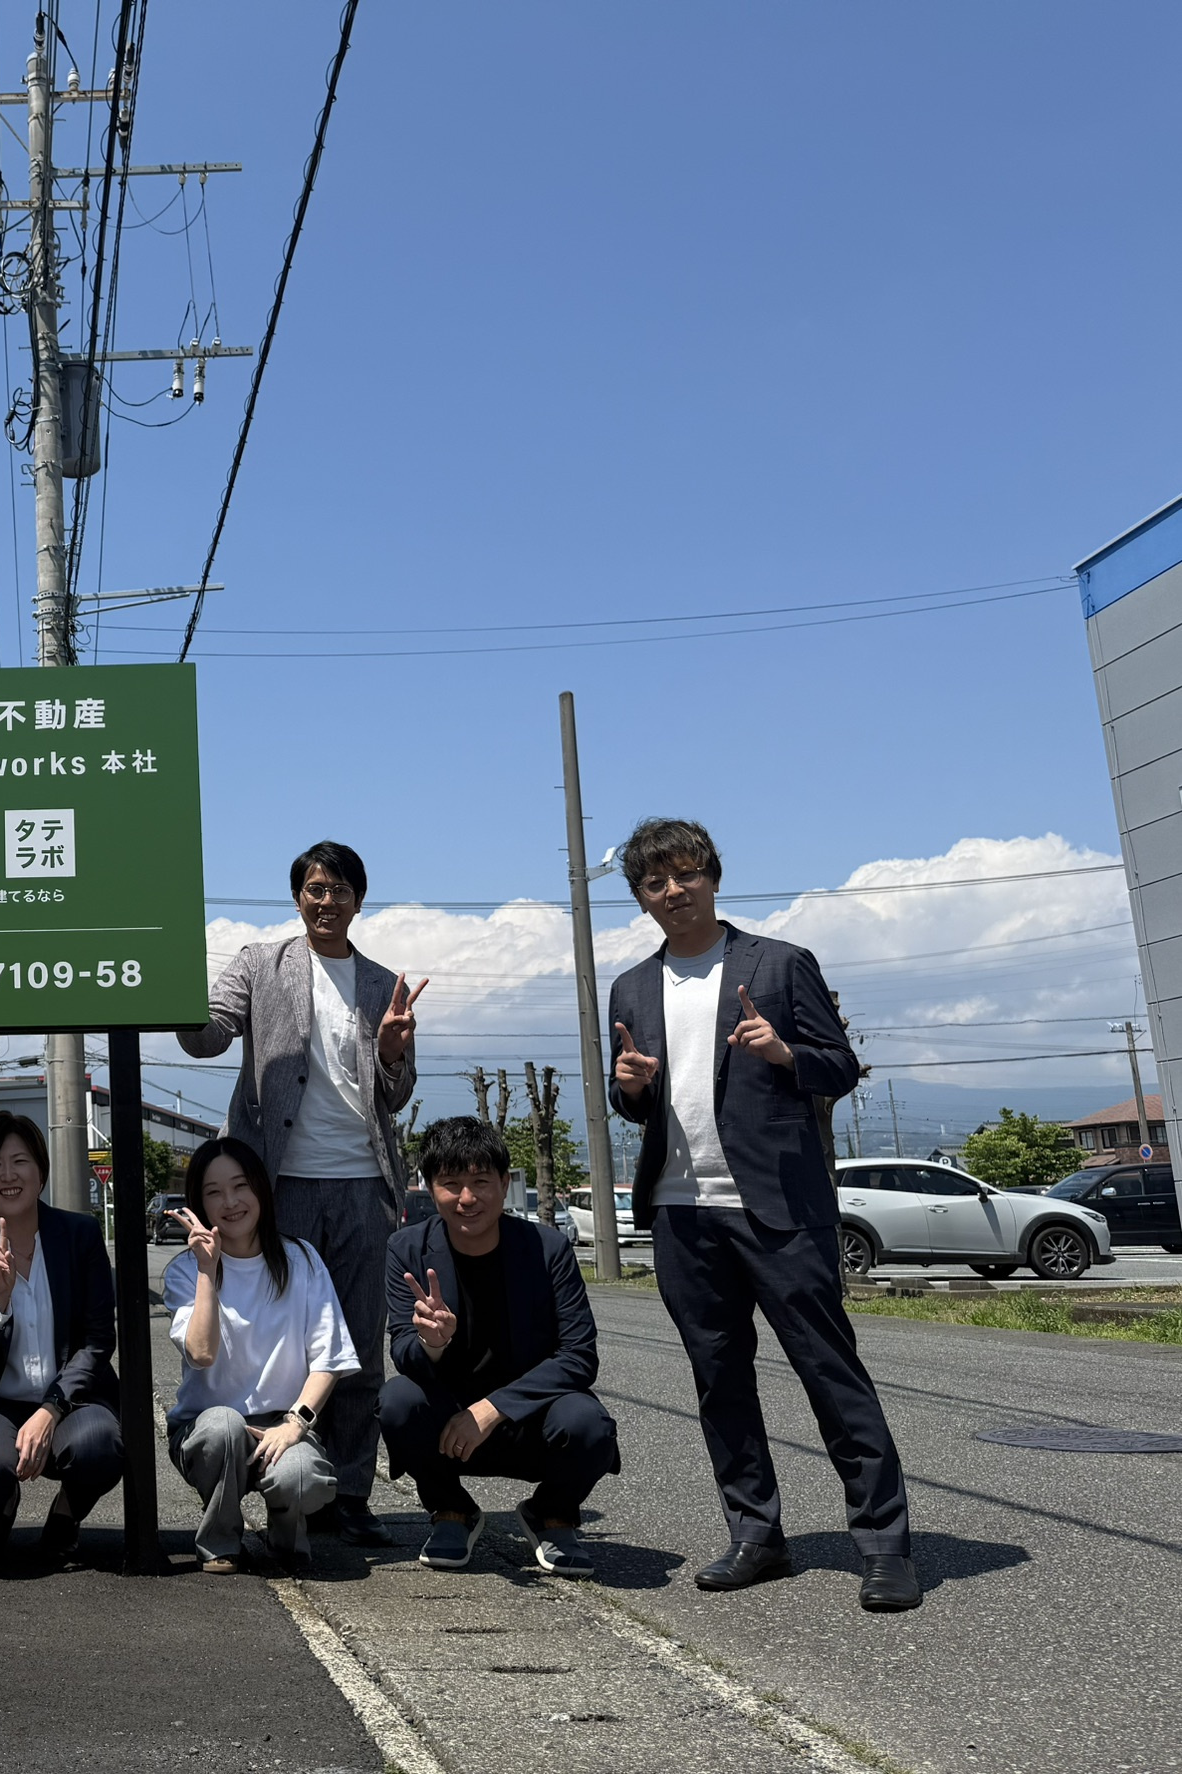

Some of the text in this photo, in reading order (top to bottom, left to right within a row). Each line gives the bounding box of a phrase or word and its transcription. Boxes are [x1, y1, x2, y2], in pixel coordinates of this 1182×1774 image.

[101, 749, 158, 775] 本社
[14, 819, 64, 843] タテ
[15, 844, 65, 869] ラボ
